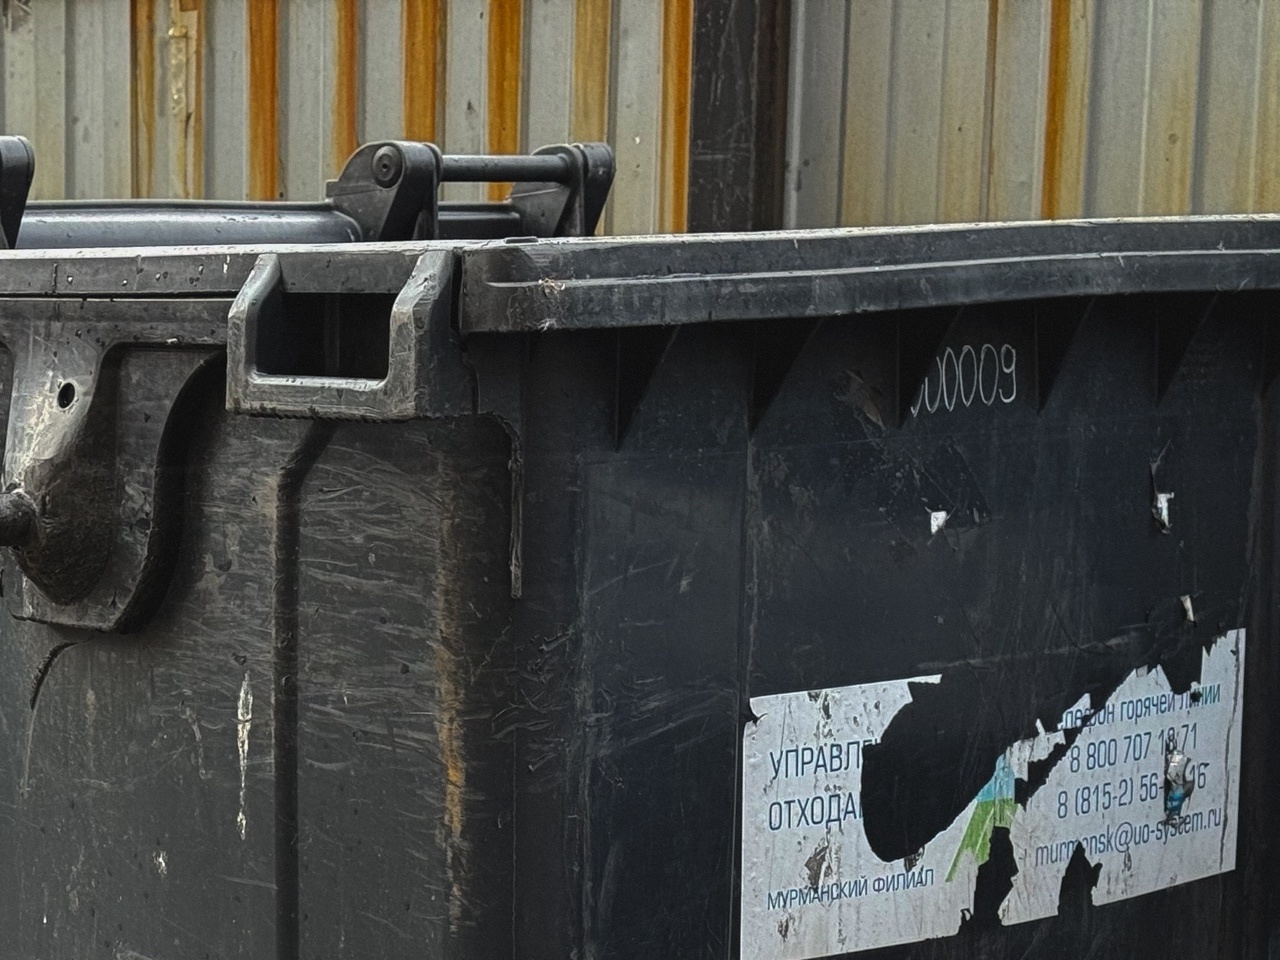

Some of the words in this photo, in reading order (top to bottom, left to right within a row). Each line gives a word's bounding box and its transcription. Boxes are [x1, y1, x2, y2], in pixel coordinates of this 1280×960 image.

[1070, 745, 1081, 774] 8
[1086, 737, 1118, 771] 800
[1123, 731, 1152, 763] 707
[1181, 722, 1198, 754] 71
[769, 792, 864, 831] ОТХОДА
[1057, 791, 1068, 819] 8
[1075, 777, 1134, 816] (815-2)
[767, 873, 868, 911] МУРМАНСКИЙ
[872, 868, 935, 893] ФИЛИАЛ
